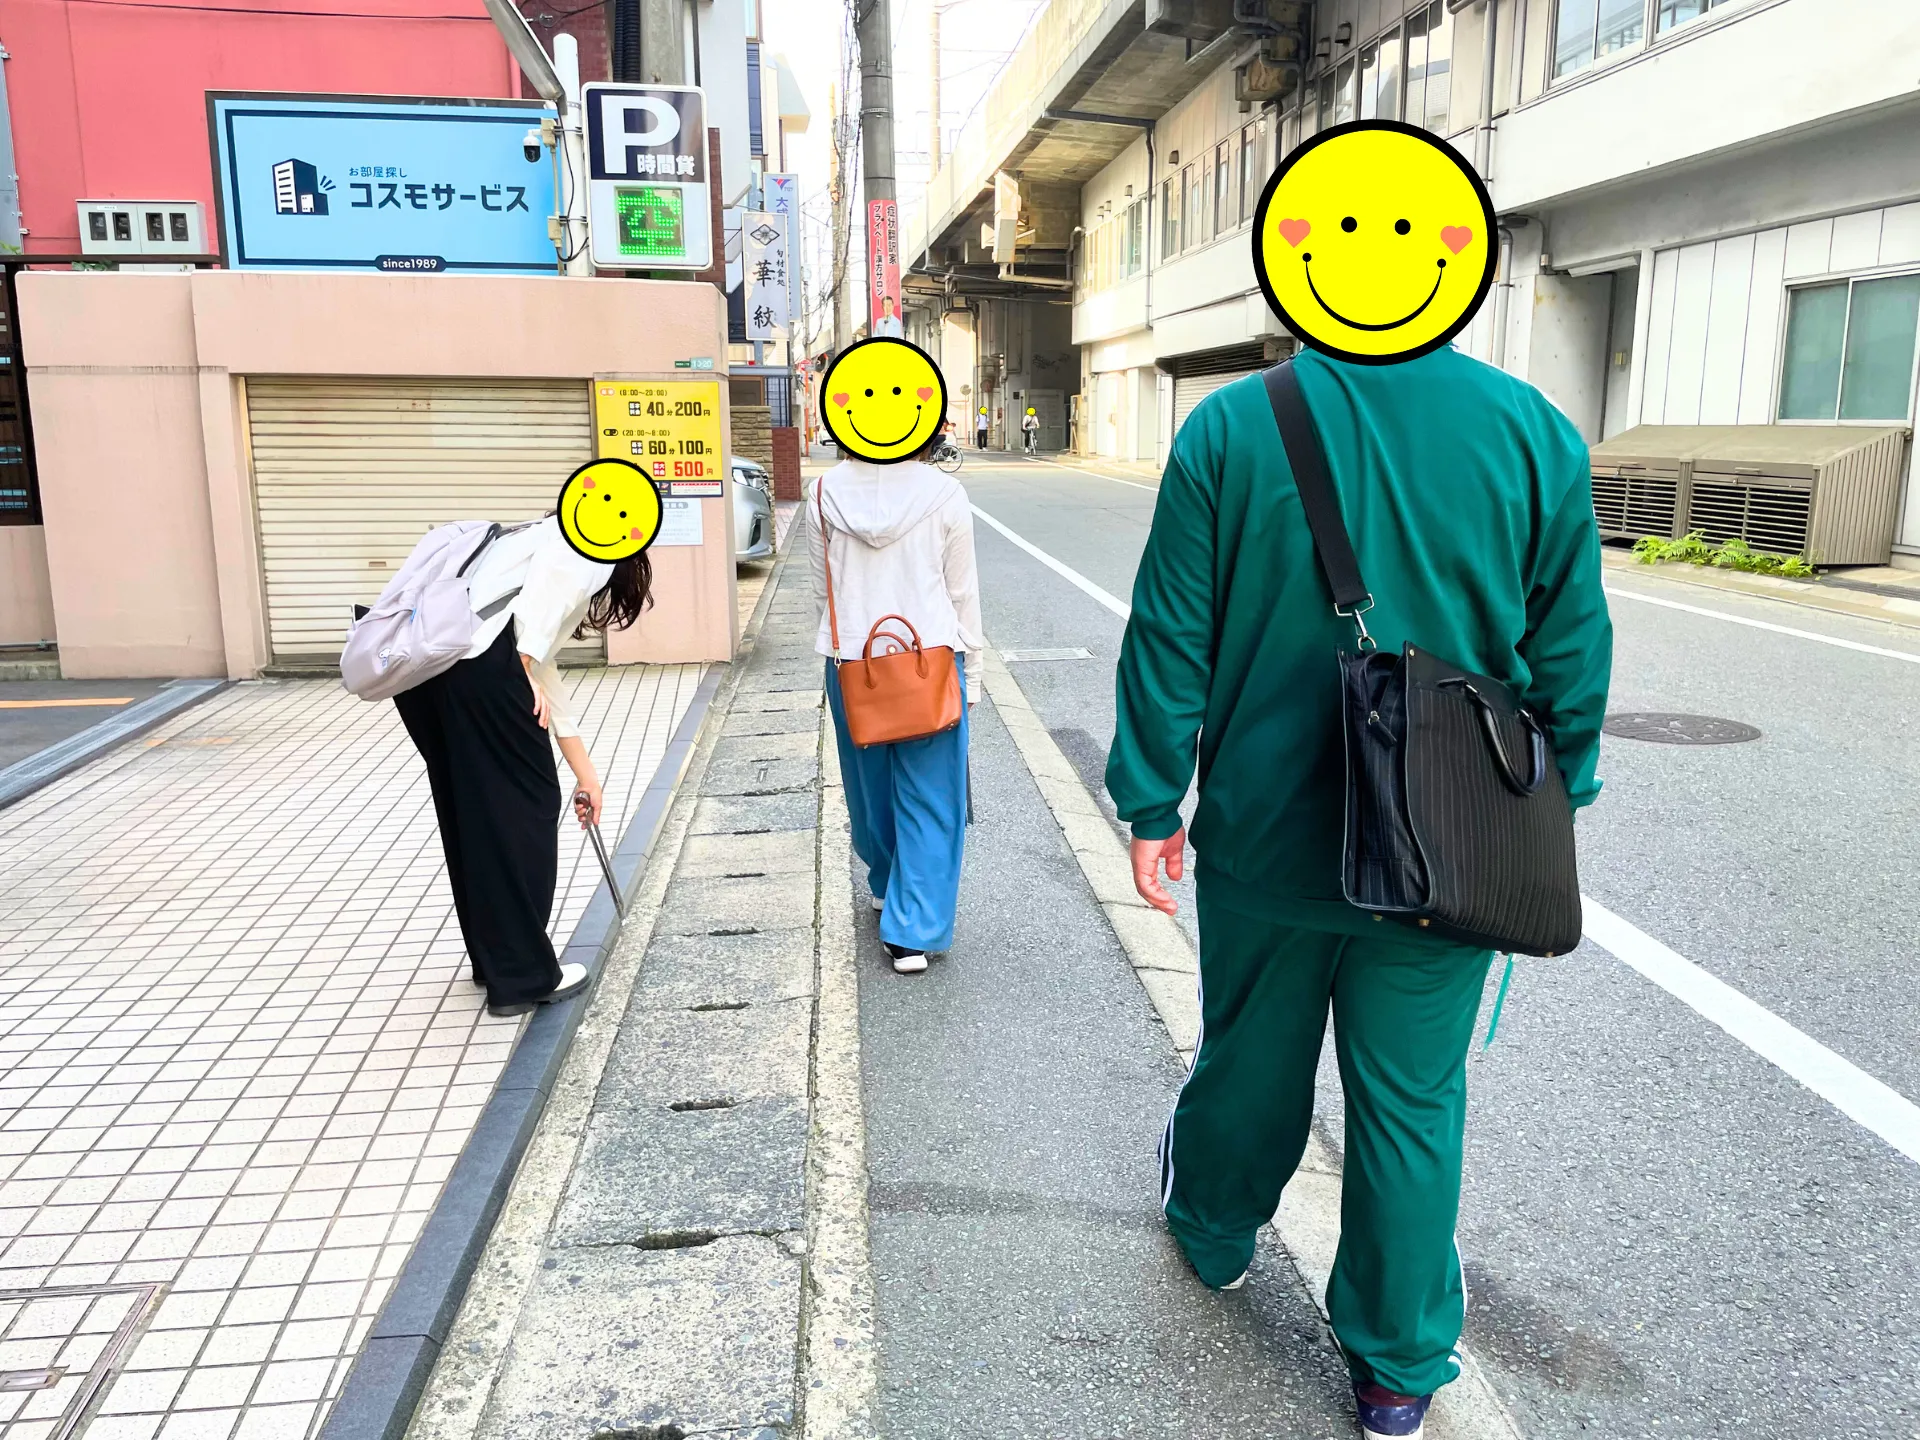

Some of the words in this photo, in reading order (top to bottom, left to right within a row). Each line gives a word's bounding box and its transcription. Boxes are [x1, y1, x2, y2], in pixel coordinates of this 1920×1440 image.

[600, 95, 681, 174] P
[349, 166, 408, 178] お部屋探し
[636, 154, 695, 176] 時間貸
[349, 183, 530, 212] コスモサービス
[617, 187, 686, 256] 空
[382, 258, 438, 269] since1989
[776, 249, 786, 287] 旬材食処
[752, 259, 777, 329] 華紋
